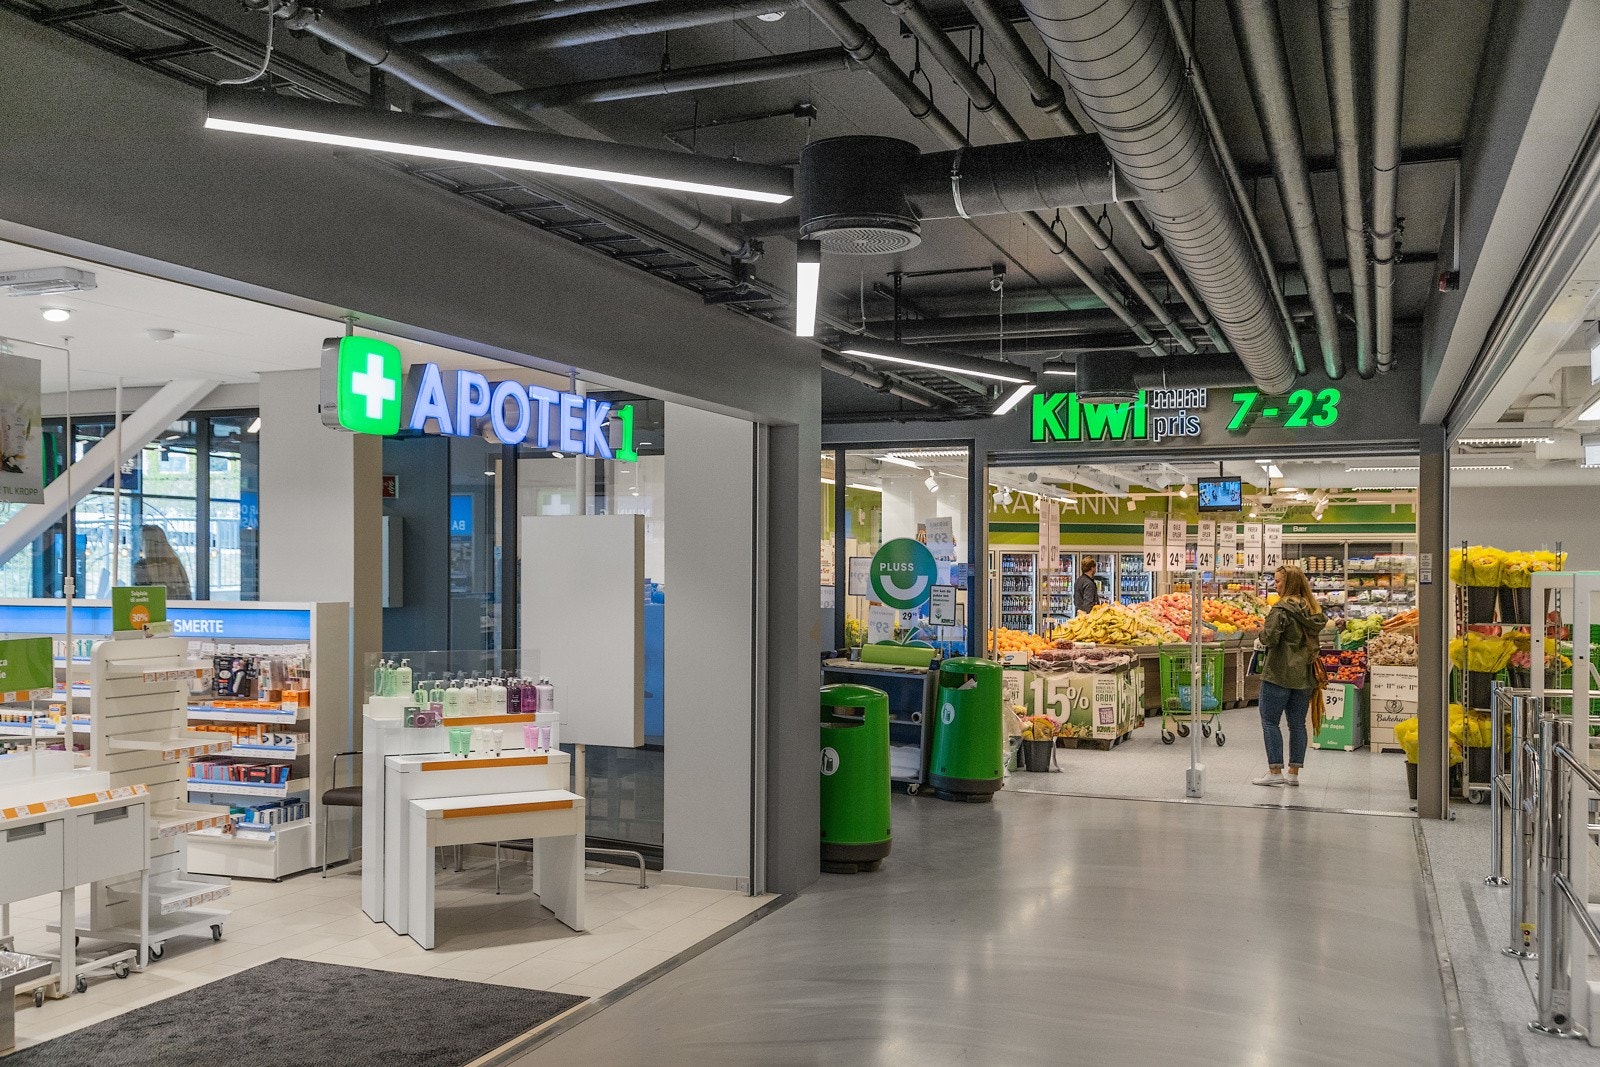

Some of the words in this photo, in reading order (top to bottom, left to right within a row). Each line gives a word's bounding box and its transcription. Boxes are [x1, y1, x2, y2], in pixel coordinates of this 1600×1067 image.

[1152, 387, 1207, 409] mini
[409, 362, 614, 459] APOTEK
[1152, 410, 1201, 442] pris
[879, 562, 914, 572] PLUSS
[174, 619, 224, 633] SMERTE
